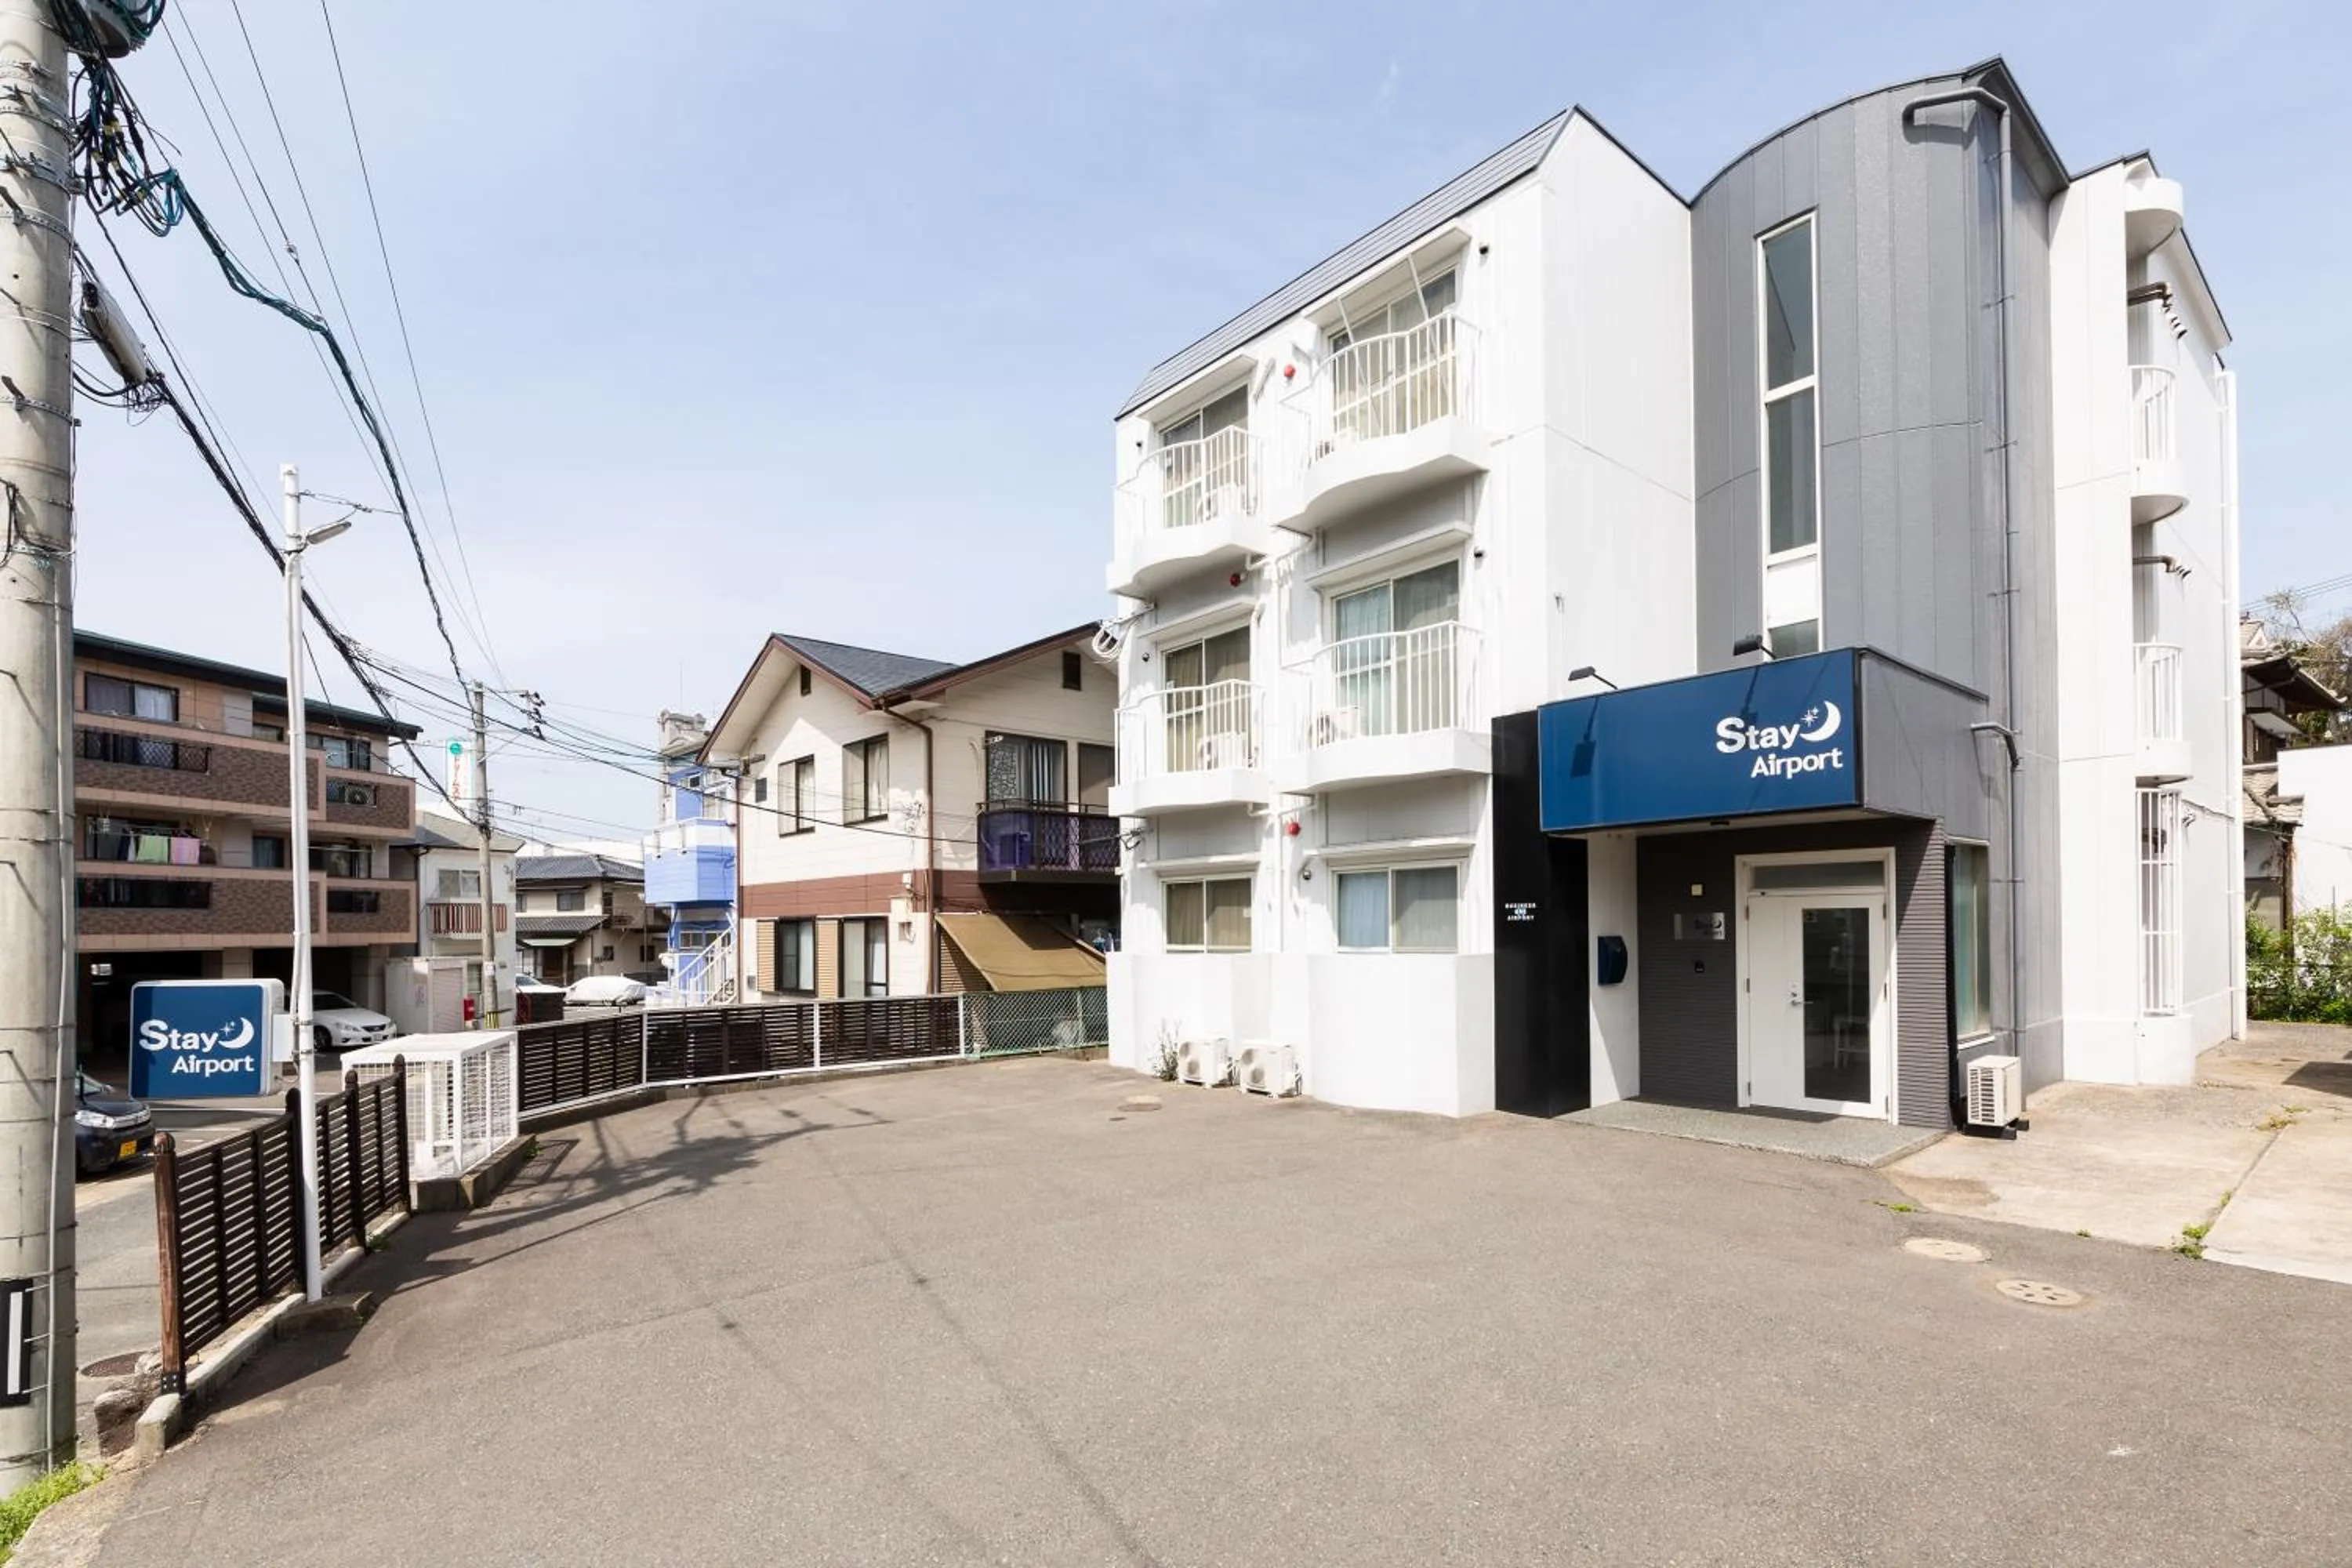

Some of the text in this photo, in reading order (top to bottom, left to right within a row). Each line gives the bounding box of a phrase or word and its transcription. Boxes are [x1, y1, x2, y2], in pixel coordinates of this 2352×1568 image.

[1716, 717, 1800, 753] Stay
[1751, 747, 1843, 779] Airport
[139, 1019, 219, 1052] Stay
[171, 1054, 255, 1078] Airport
